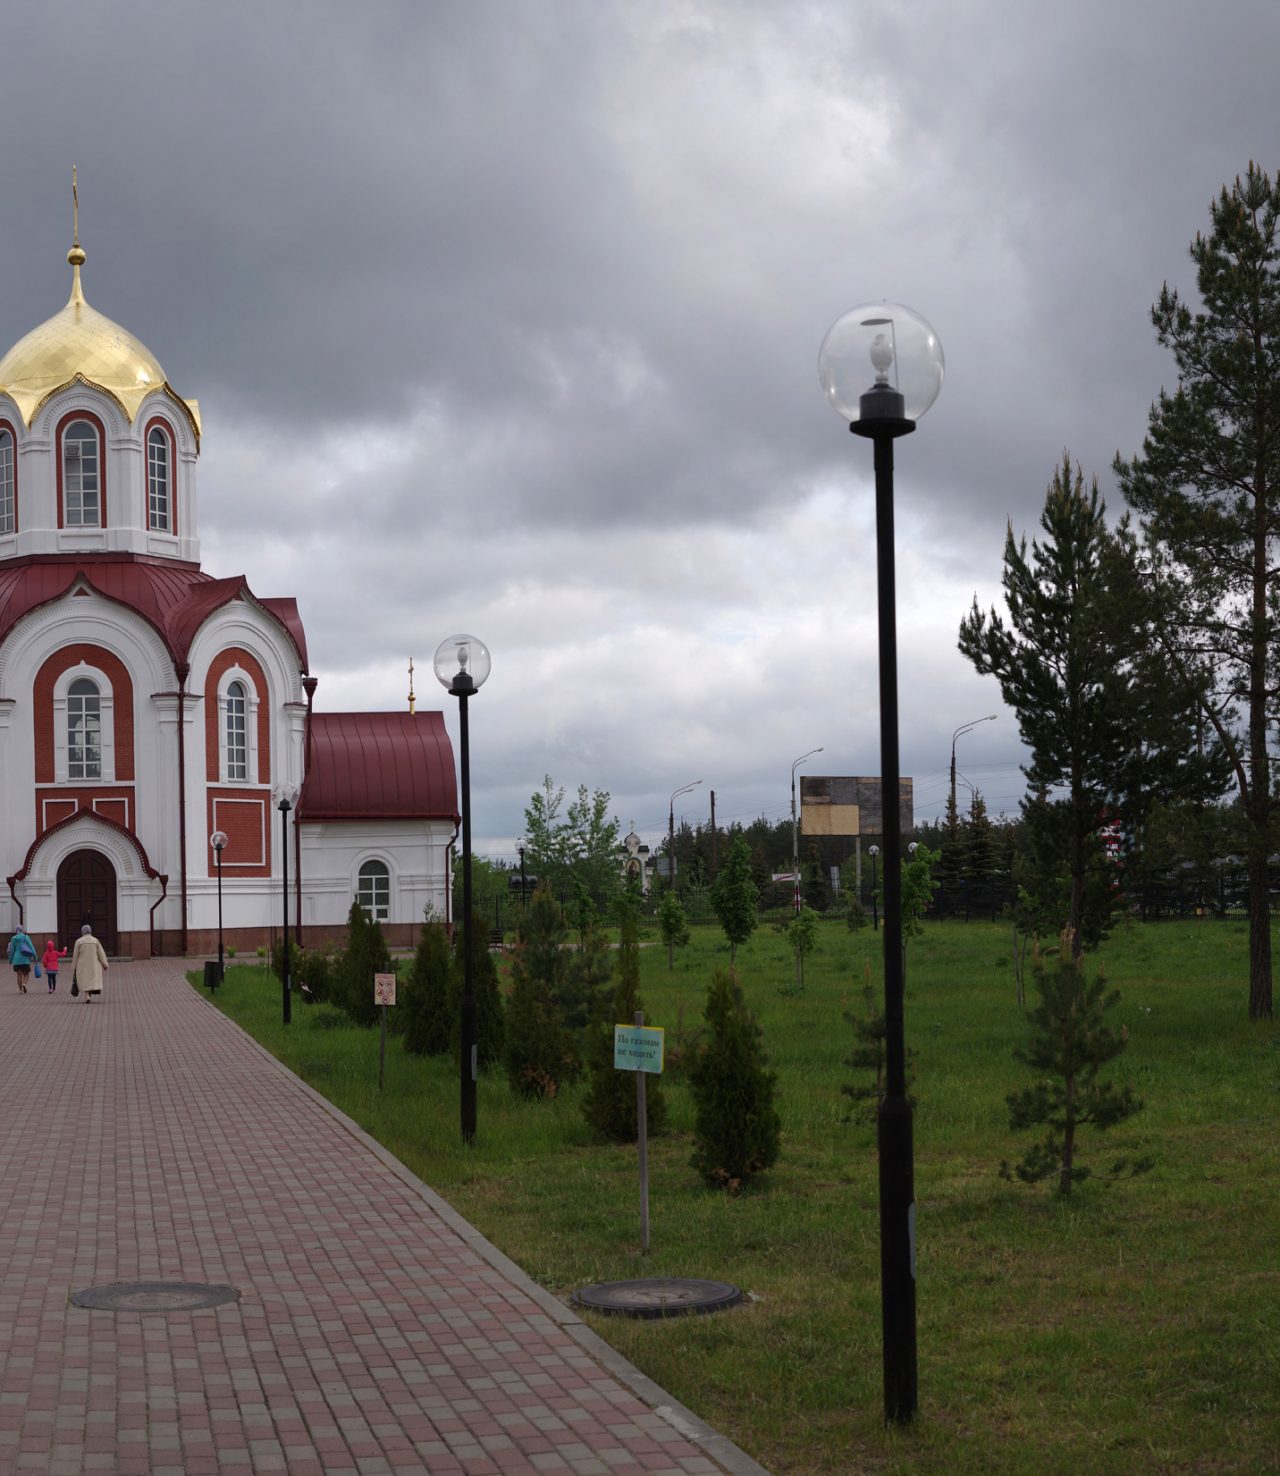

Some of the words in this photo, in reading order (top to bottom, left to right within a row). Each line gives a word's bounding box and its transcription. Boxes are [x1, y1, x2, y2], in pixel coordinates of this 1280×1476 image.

[618, 1034, 629, 1044] По
[630, 1037, 660, 1047] газонам
[617, 1048, 627, 1056] не
[628, 1049, 656, 1059] ходить!
